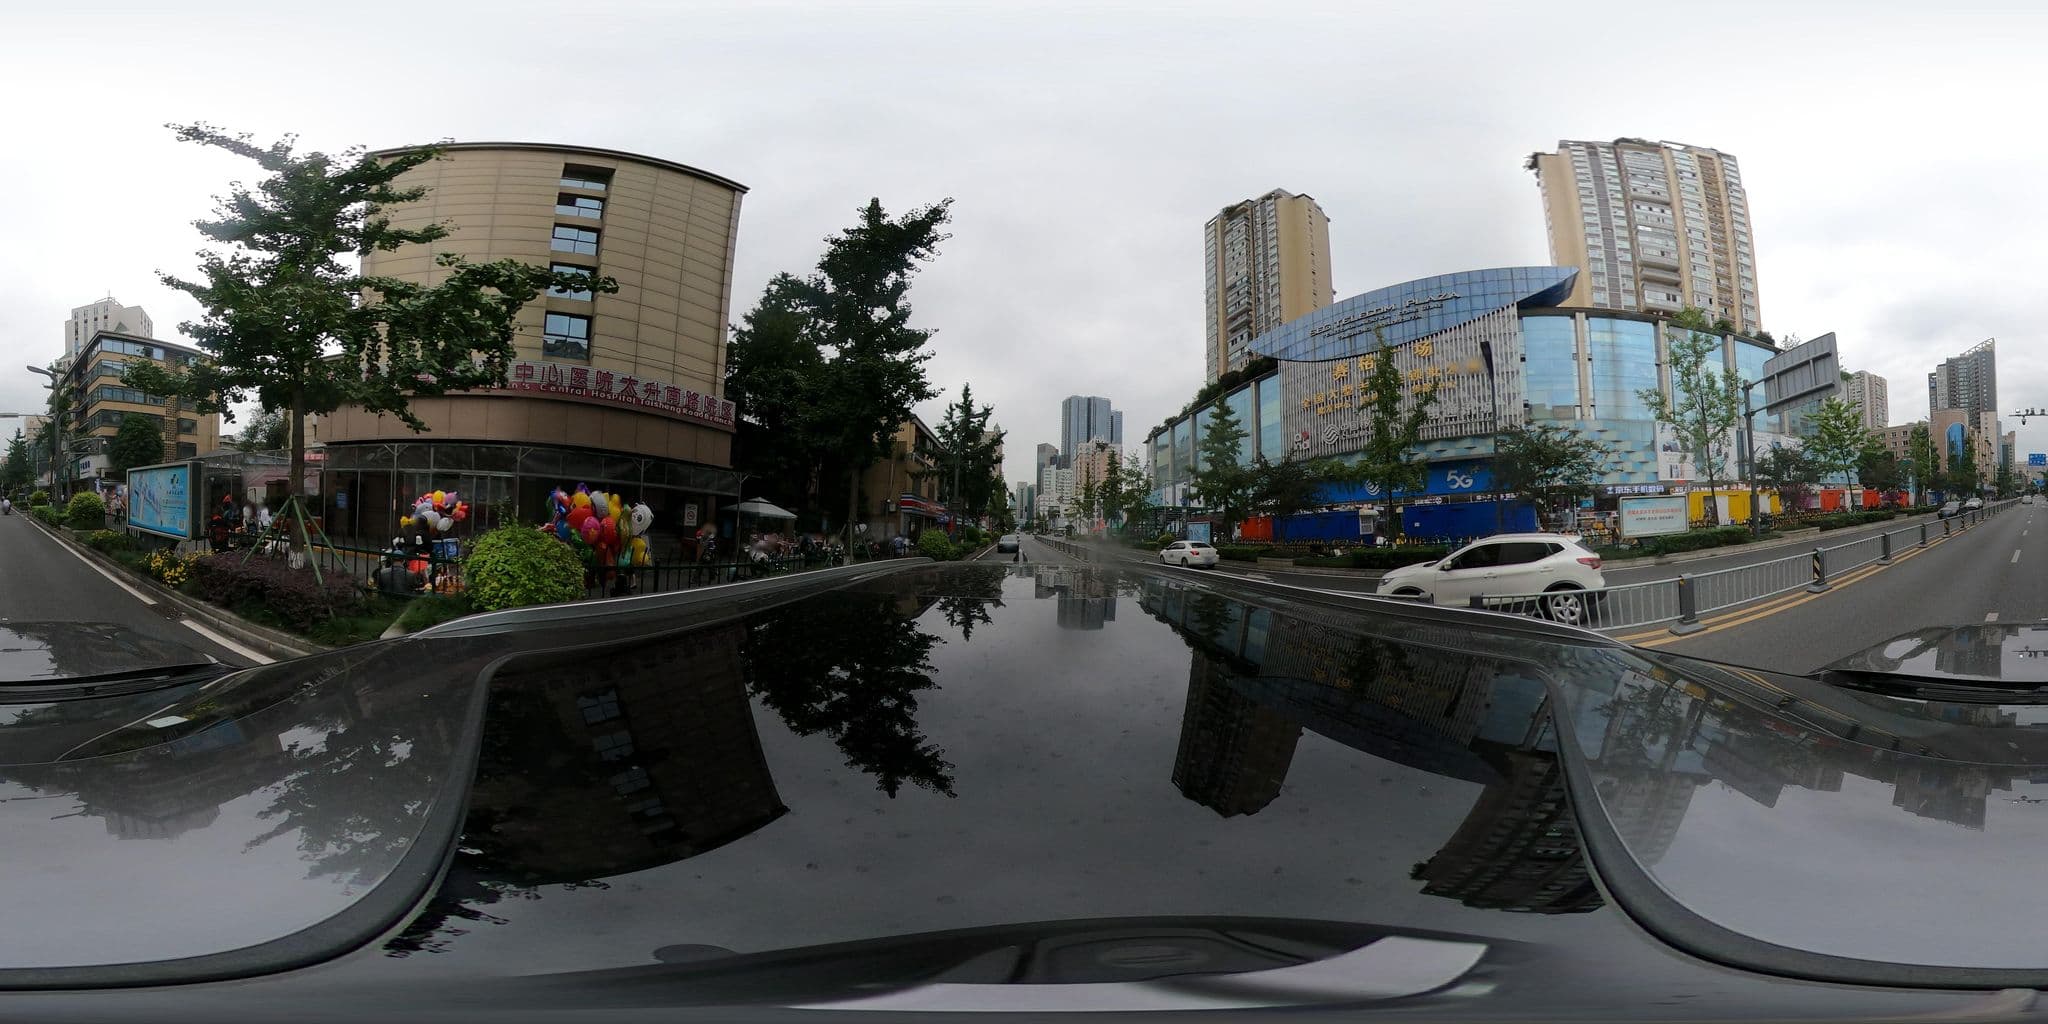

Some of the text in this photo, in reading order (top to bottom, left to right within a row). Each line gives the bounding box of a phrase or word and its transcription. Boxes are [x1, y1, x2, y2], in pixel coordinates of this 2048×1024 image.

[1334, 304, 1396, 328] TELECOM
[1406, 291, 1461, 307] PLAZA
[540, 383, 586, 396] Central
[591, 390, 636, 404] Hospital
[1446, 470, 1474, 489] 5G
